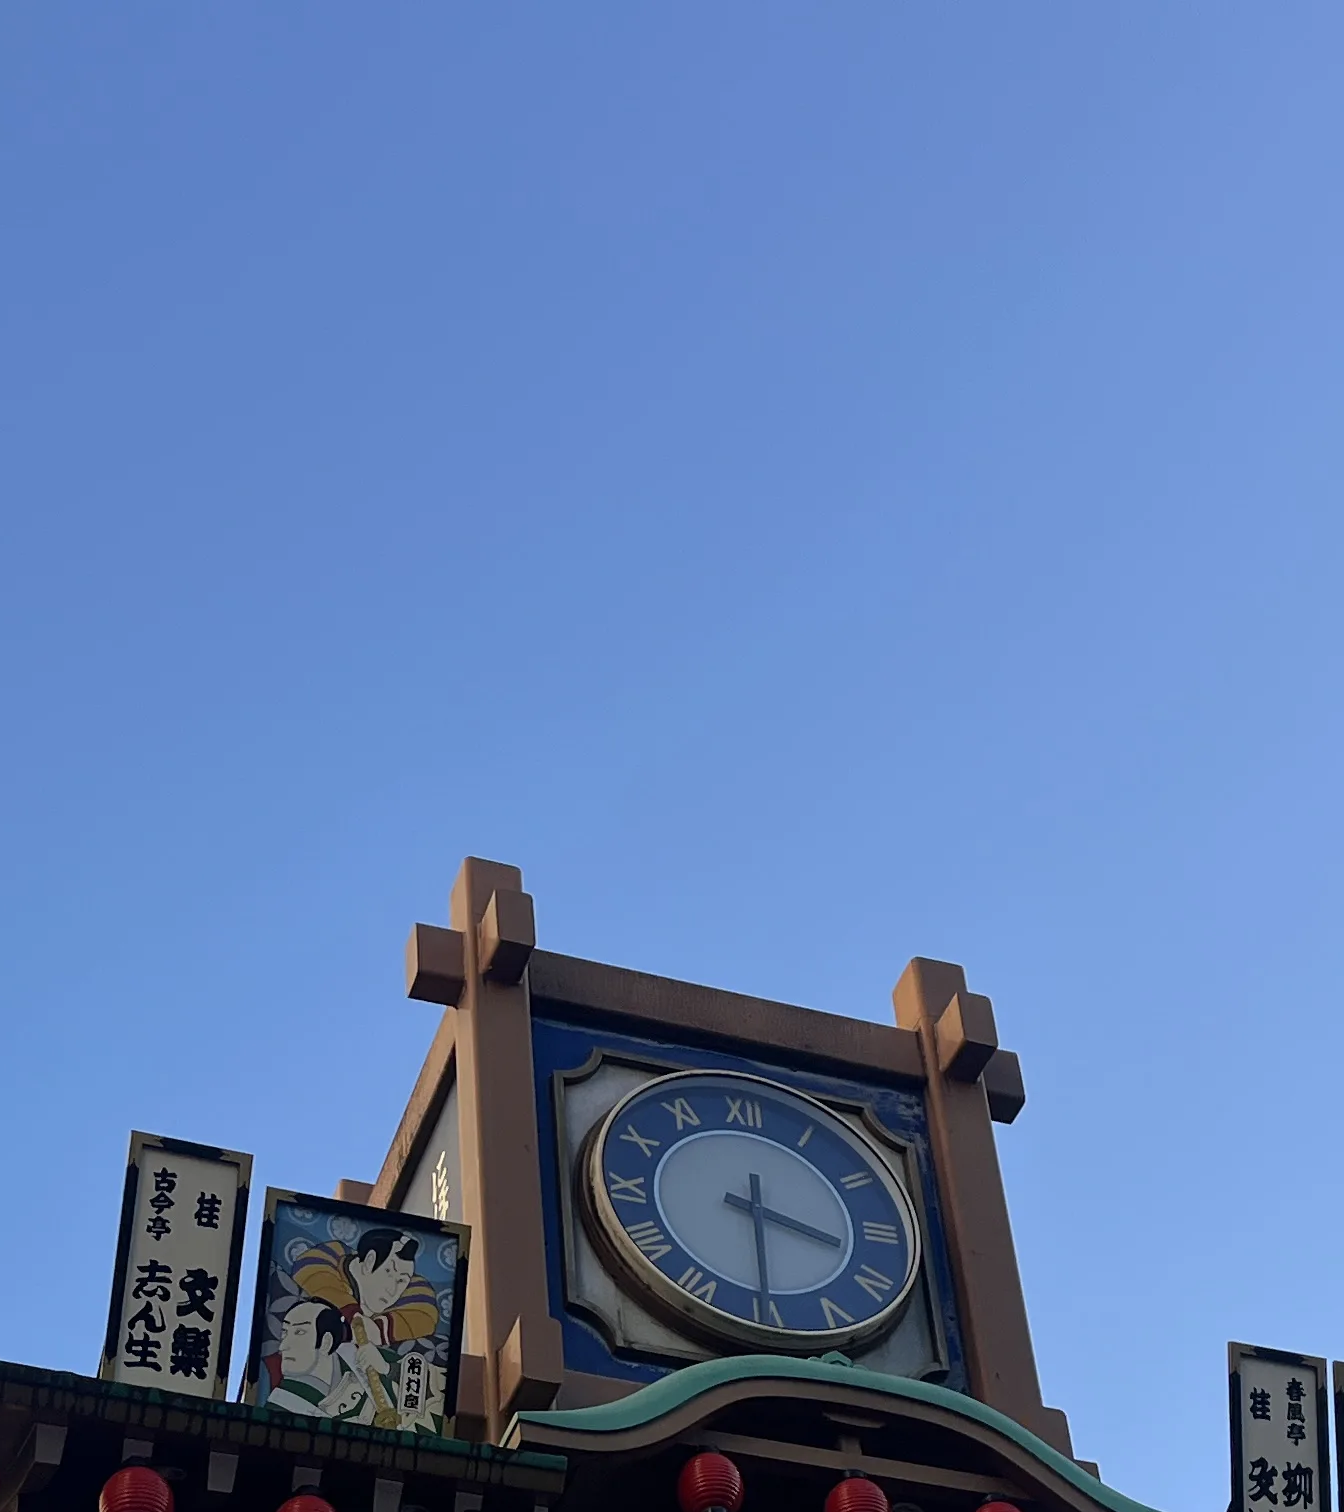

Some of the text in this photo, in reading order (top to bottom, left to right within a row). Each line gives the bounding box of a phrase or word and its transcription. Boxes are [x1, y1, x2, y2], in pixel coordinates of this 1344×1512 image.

[725, 1096, 762, 1128] XII
[619, 1125, 660, 1157] X
[797, 1125, 815, 1147] I
[609, 1171, 647, 1204] IX
[840, 1171, 873, 1190] II
[862, 1221, 898, 1244] III
